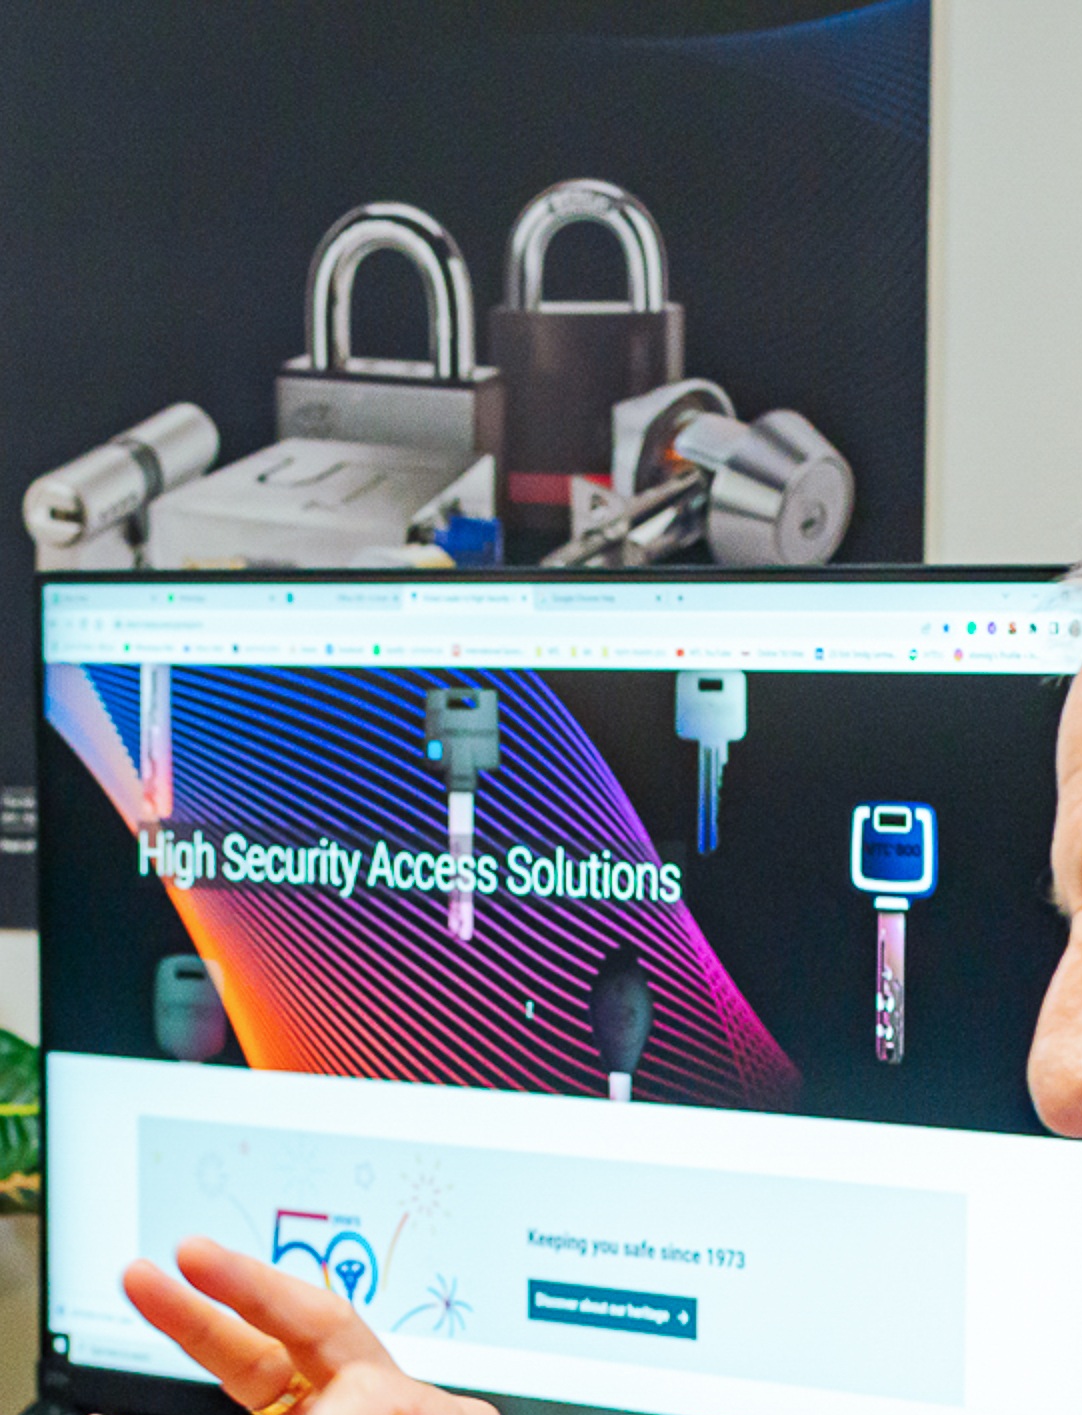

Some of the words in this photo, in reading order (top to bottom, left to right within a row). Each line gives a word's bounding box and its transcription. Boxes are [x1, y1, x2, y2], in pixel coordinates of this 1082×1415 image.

[138, 830, 217, 888] High
[221, 836, 362, 898] Security
[367, 840, 499, 894] Access
[506, 845, 682, 903] Solutions
[527, 1228, 588, 1257] Keeping
[592, 1242, 619, 1257] you
[623, 1239, 655, 1260] safe
[660, 1243, 701, 1265] since
[707, 1247, 746, 1270] 1973
